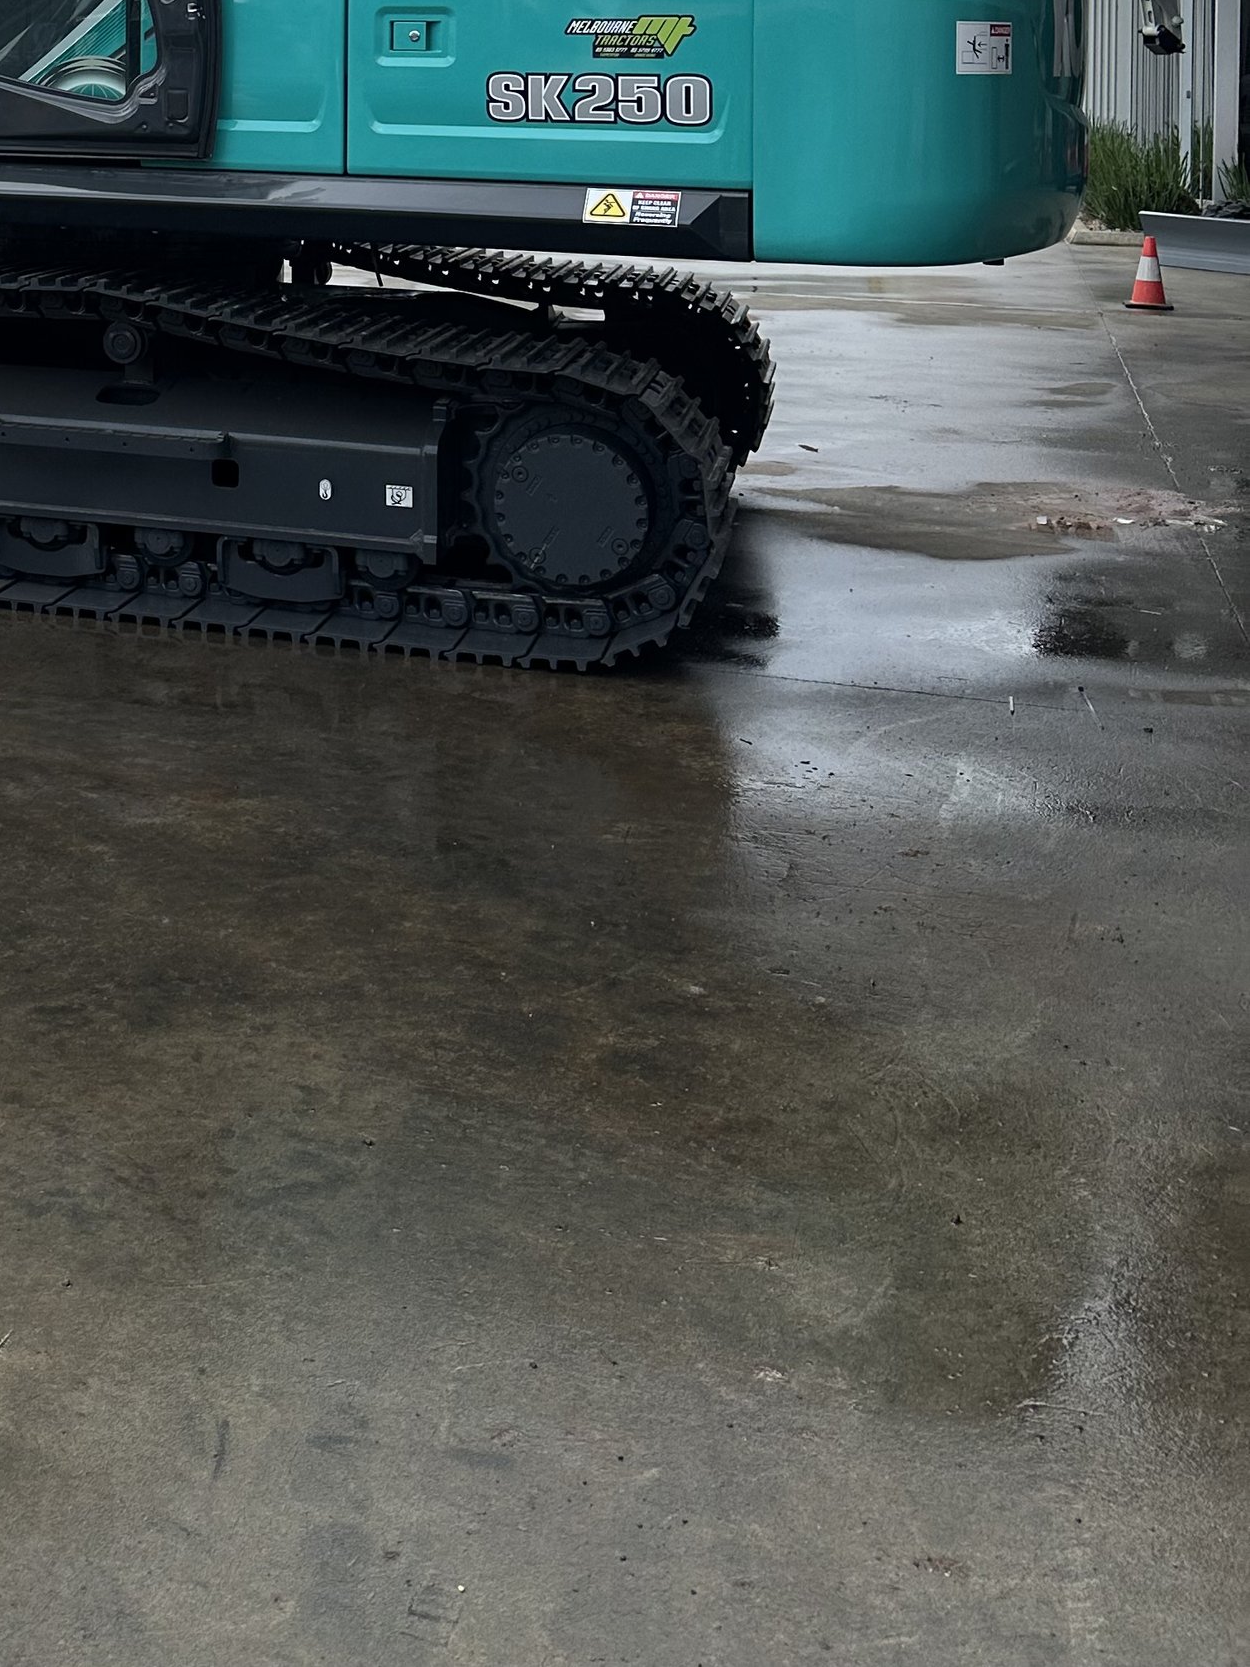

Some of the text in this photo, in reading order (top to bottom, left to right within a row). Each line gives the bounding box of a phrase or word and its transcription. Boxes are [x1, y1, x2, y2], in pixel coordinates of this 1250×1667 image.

[567, 20, 637, 34] MELBOURNE
[595, 34, 657, 46] TRACTORS
[487, 72, 713, 125] SK250
